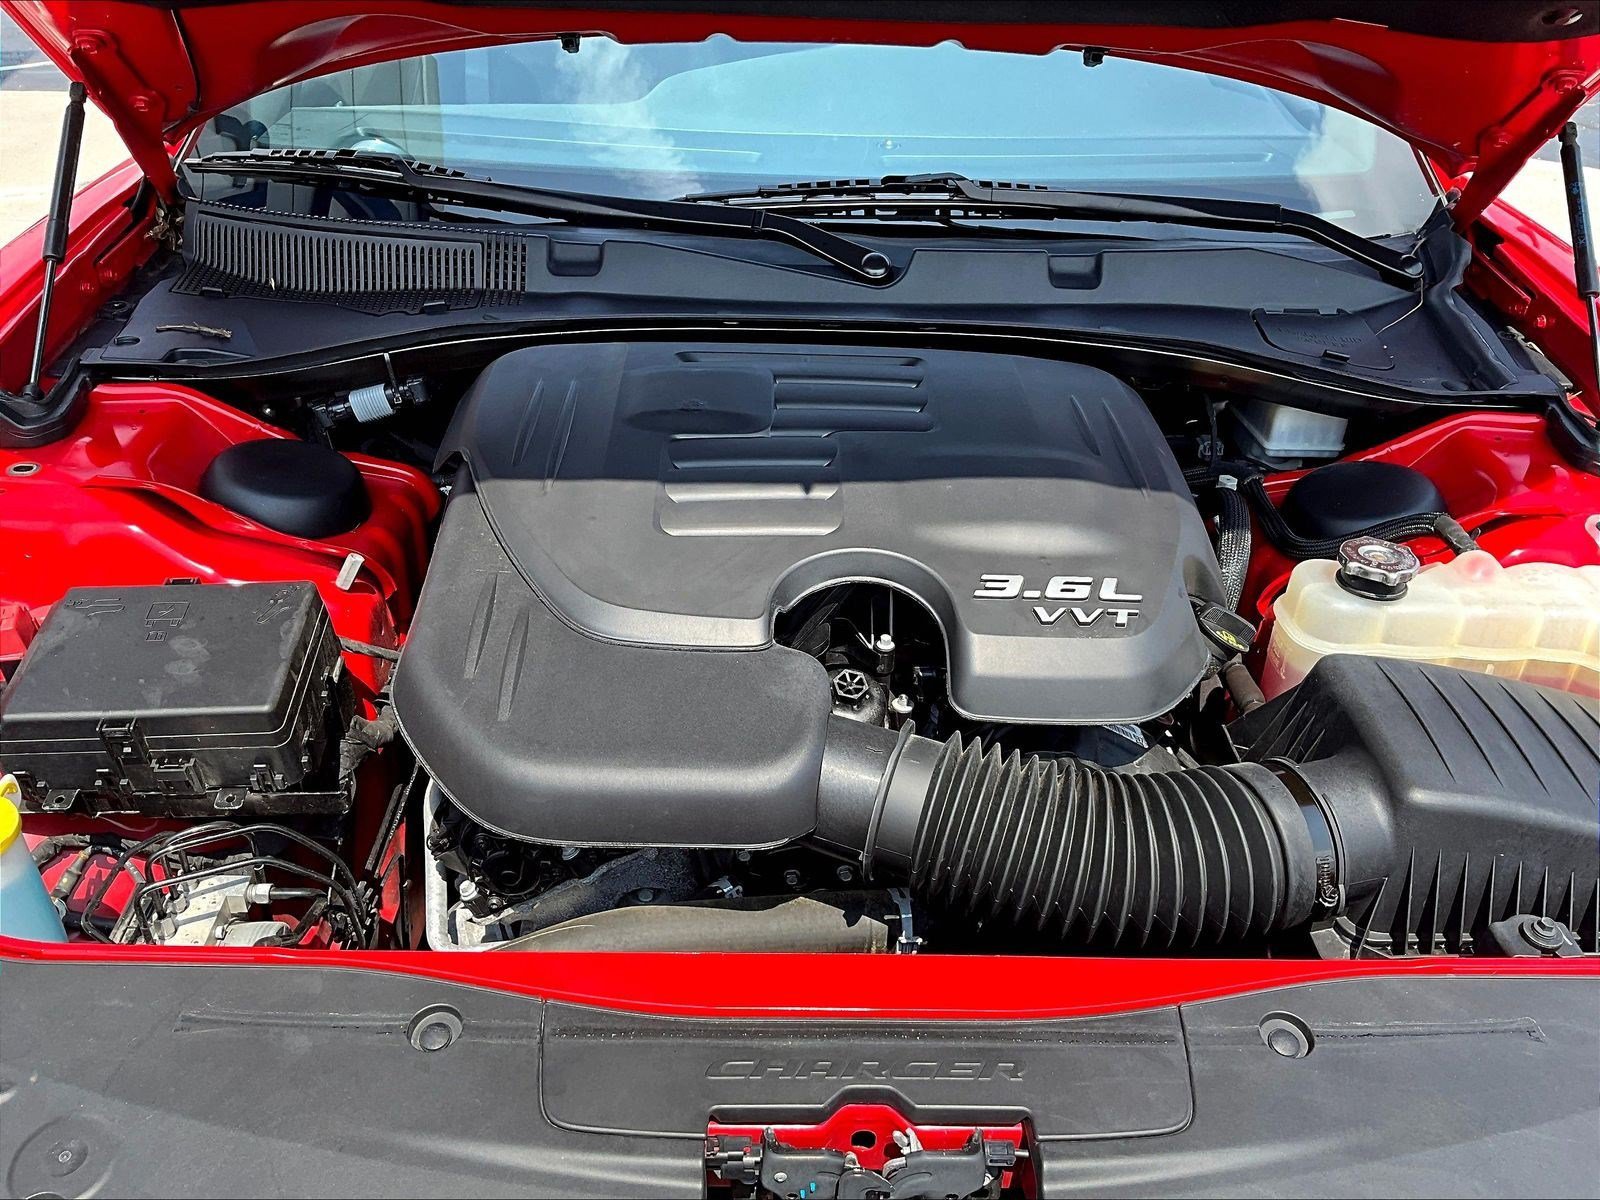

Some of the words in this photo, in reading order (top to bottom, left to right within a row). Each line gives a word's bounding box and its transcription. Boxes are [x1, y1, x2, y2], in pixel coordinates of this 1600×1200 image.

[973, 574, 1143, 603] 3.6L
[1032, 606, 1140, 627] VVT
[704, 1060, 1026, 1082] CHARGER
